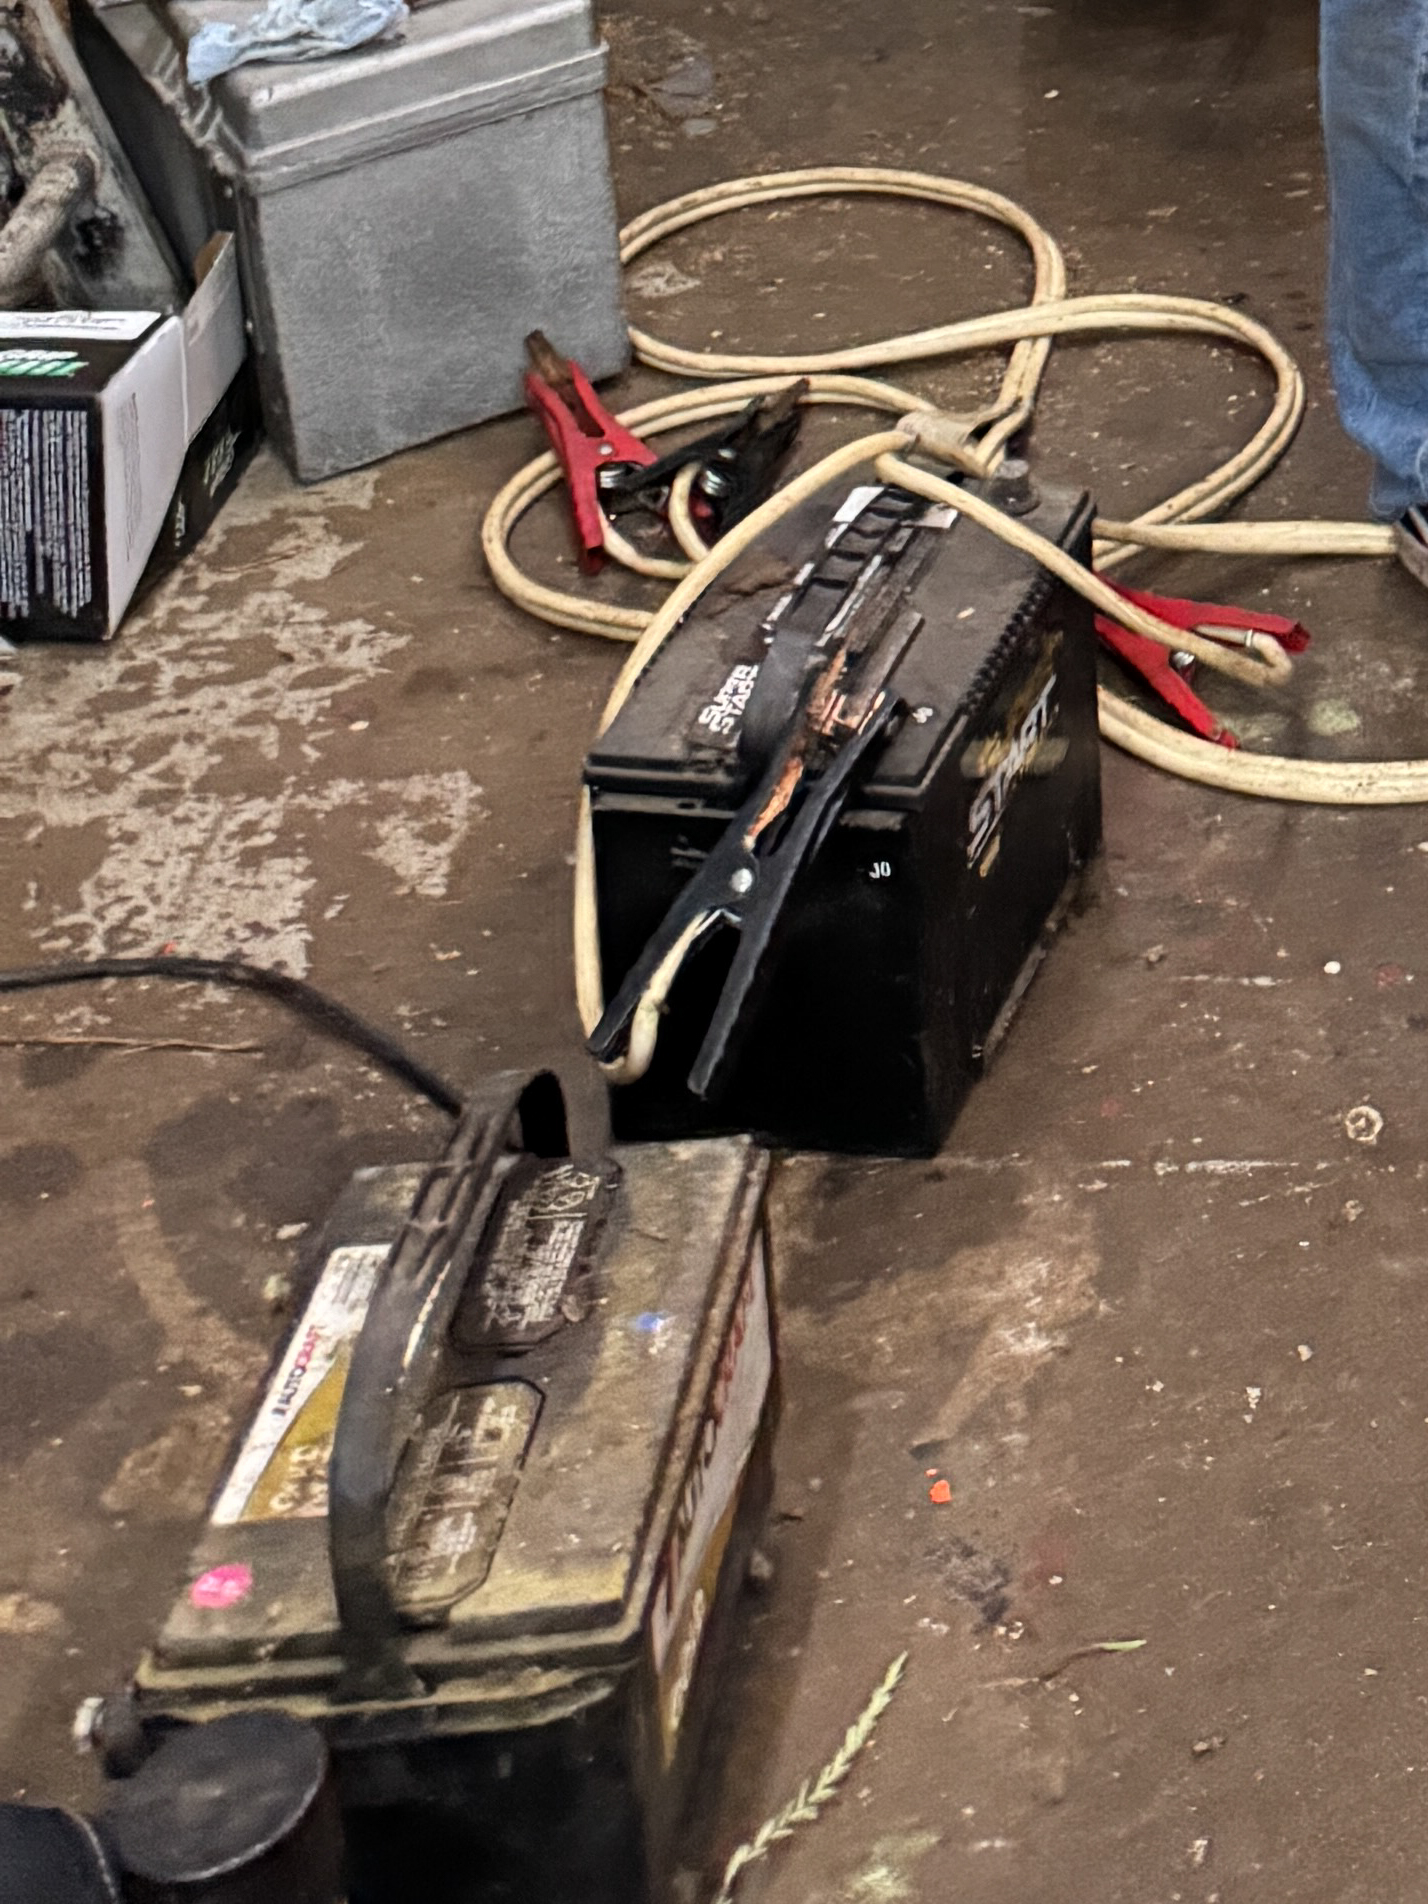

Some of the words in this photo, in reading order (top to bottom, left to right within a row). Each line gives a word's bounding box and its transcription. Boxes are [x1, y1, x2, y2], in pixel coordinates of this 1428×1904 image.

[698, 664, 755, 725] SUPER
[707, 664, 759, 735] START
[966, 673, 1058, 870] START
